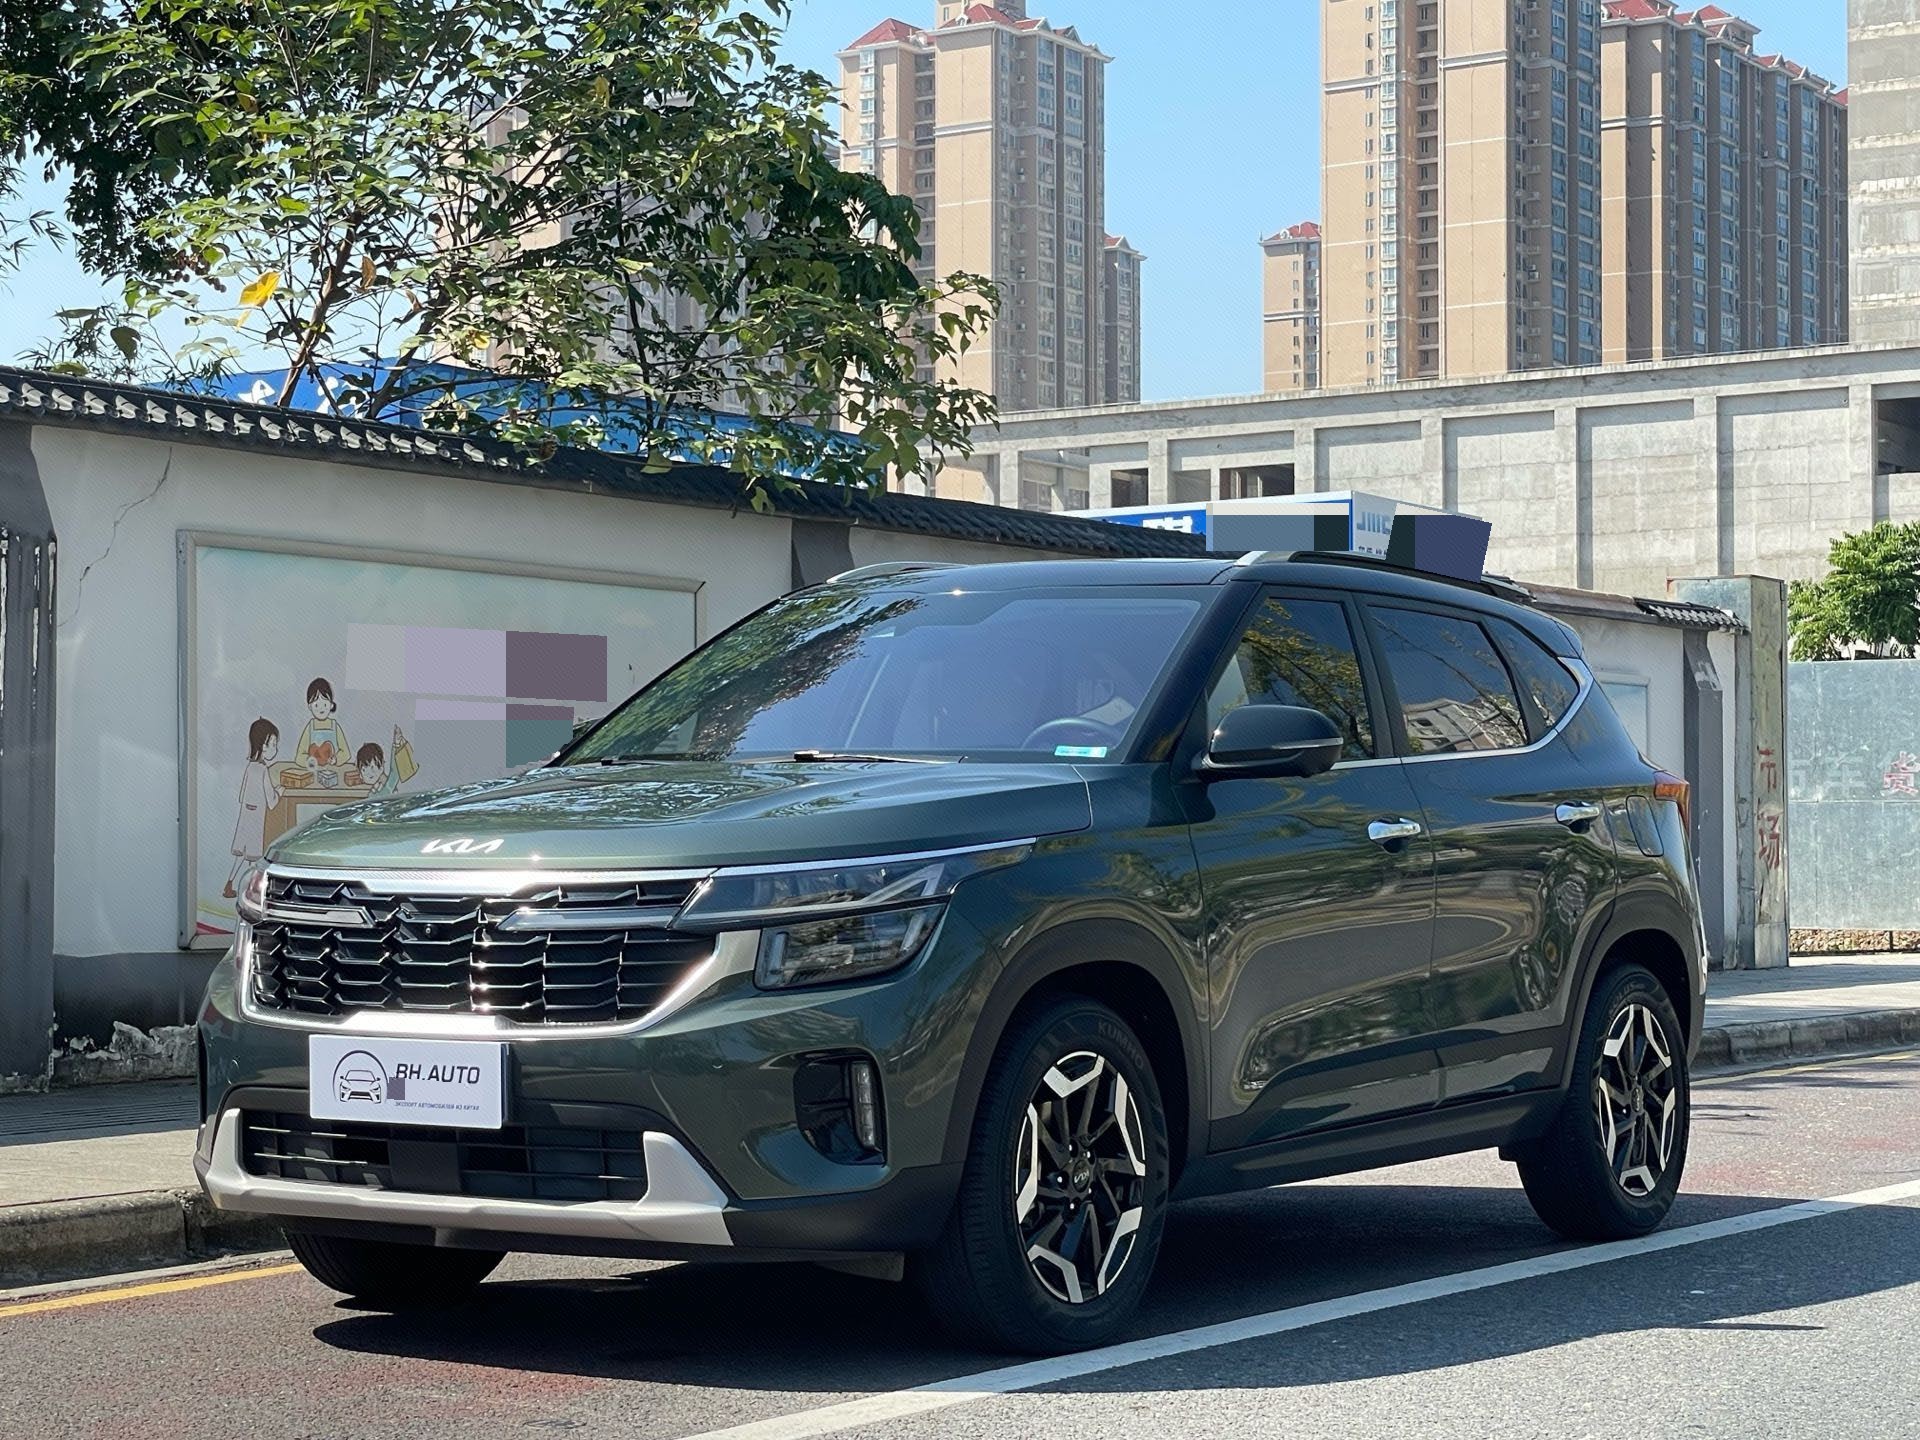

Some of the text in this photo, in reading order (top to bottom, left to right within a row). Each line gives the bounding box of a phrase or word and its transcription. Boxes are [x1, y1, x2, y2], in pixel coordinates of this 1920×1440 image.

[421, 838, 504, 854] KIA
[1098, 1020, 1144, 1070] KUMHO
[395, 1063, 481, 1084] BH.AUTO
